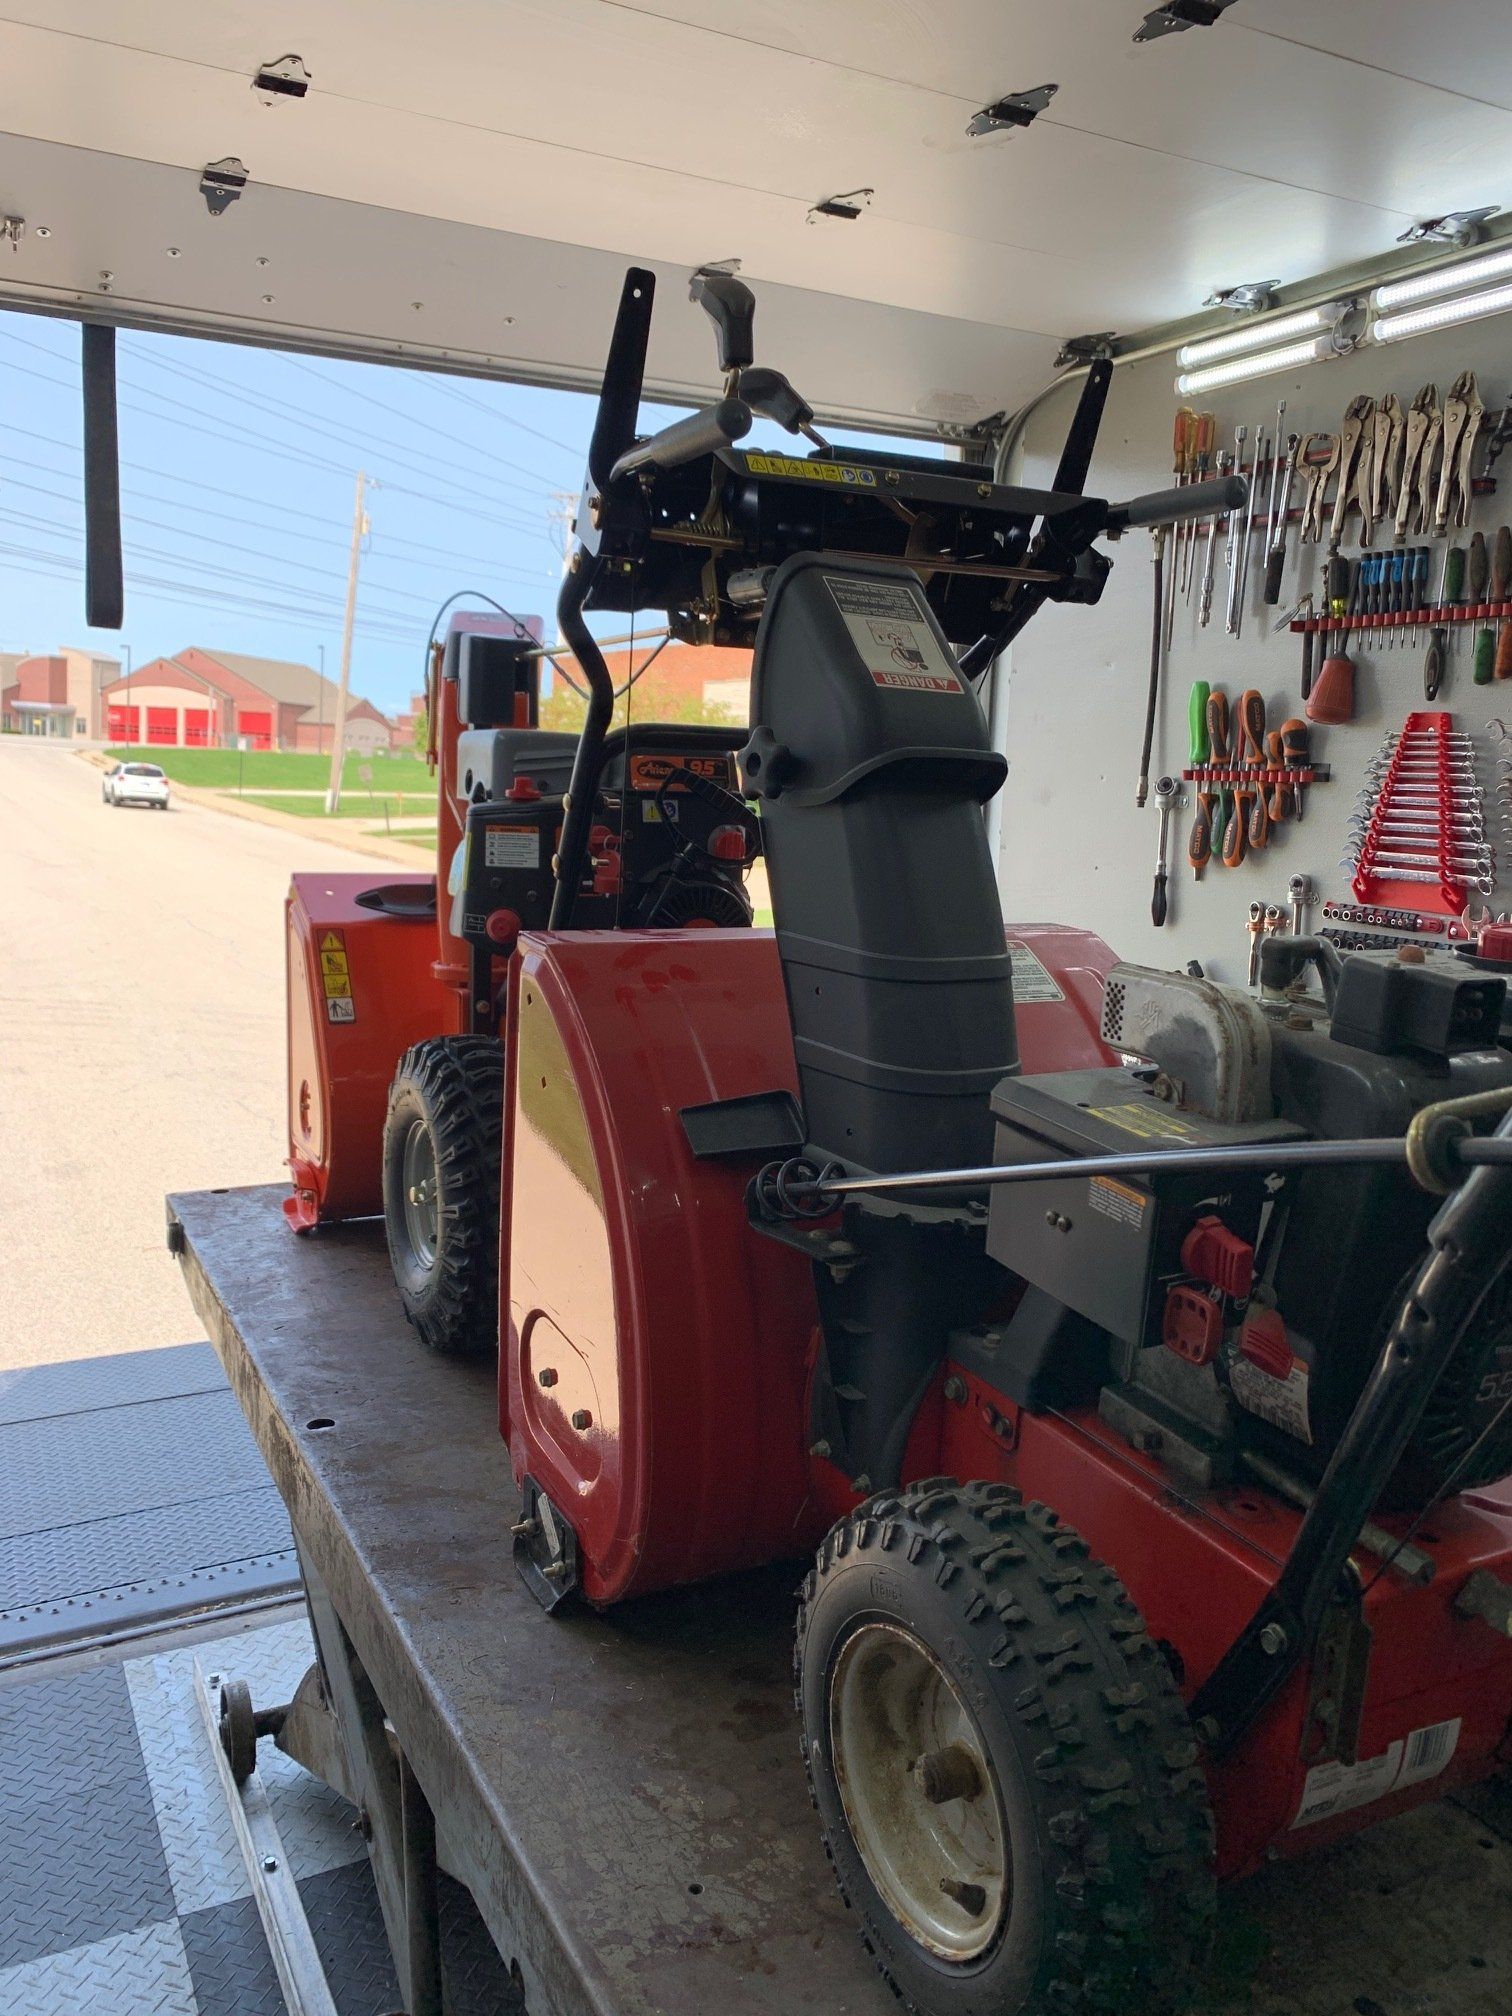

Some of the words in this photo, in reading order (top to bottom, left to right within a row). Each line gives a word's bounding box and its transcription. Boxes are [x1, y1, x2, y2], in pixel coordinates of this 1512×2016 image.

[882, 673, 935, 688] DANGER
[1194, 824, 1203, 853] MATCO
[1223, 823, 1234, 853] MATCO
